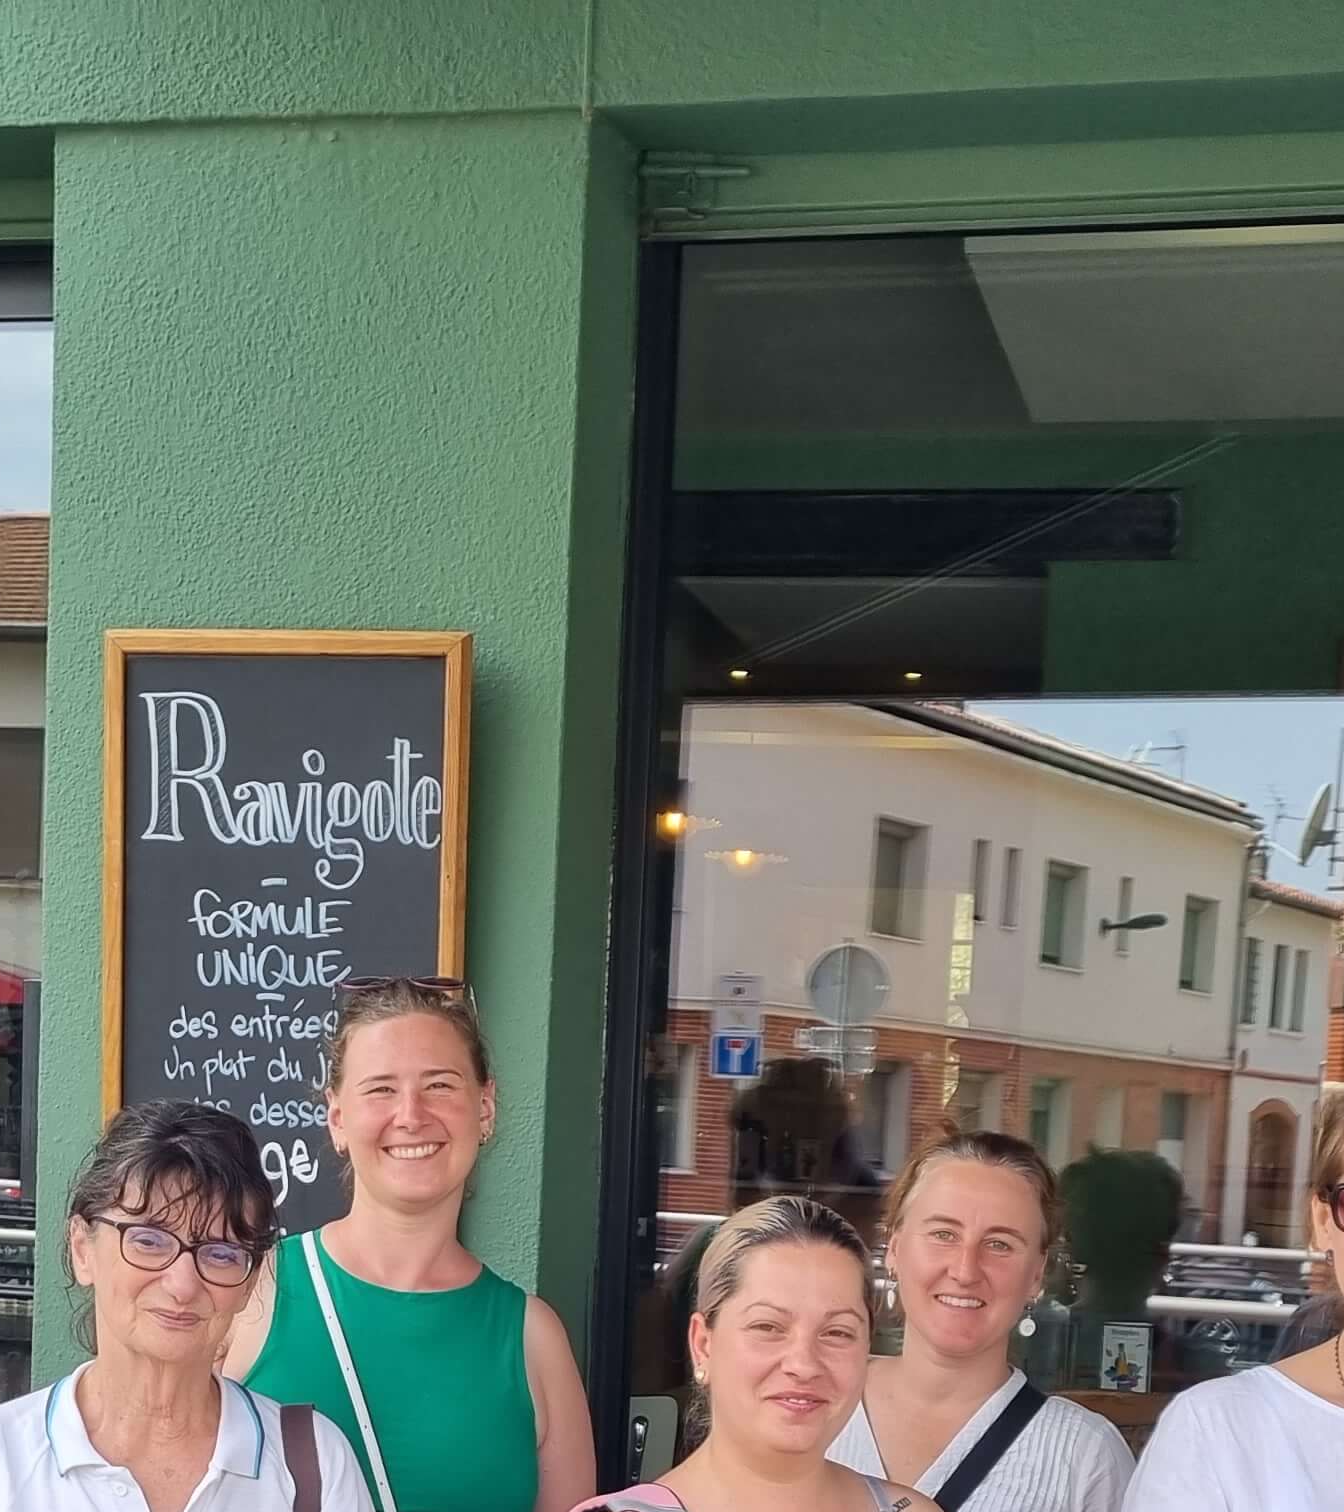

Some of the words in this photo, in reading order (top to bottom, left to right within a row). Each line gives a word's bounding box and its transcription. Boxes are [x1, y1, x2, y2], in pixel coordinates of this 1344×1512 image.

[138, 691, 442, 889] Ravigote
[168, 1004, 219, 1039] des
[230, 998, 339, 1043] entrées
[202, 1049, 256, 1096] plat
[267, 1046, 303, 1083] du
